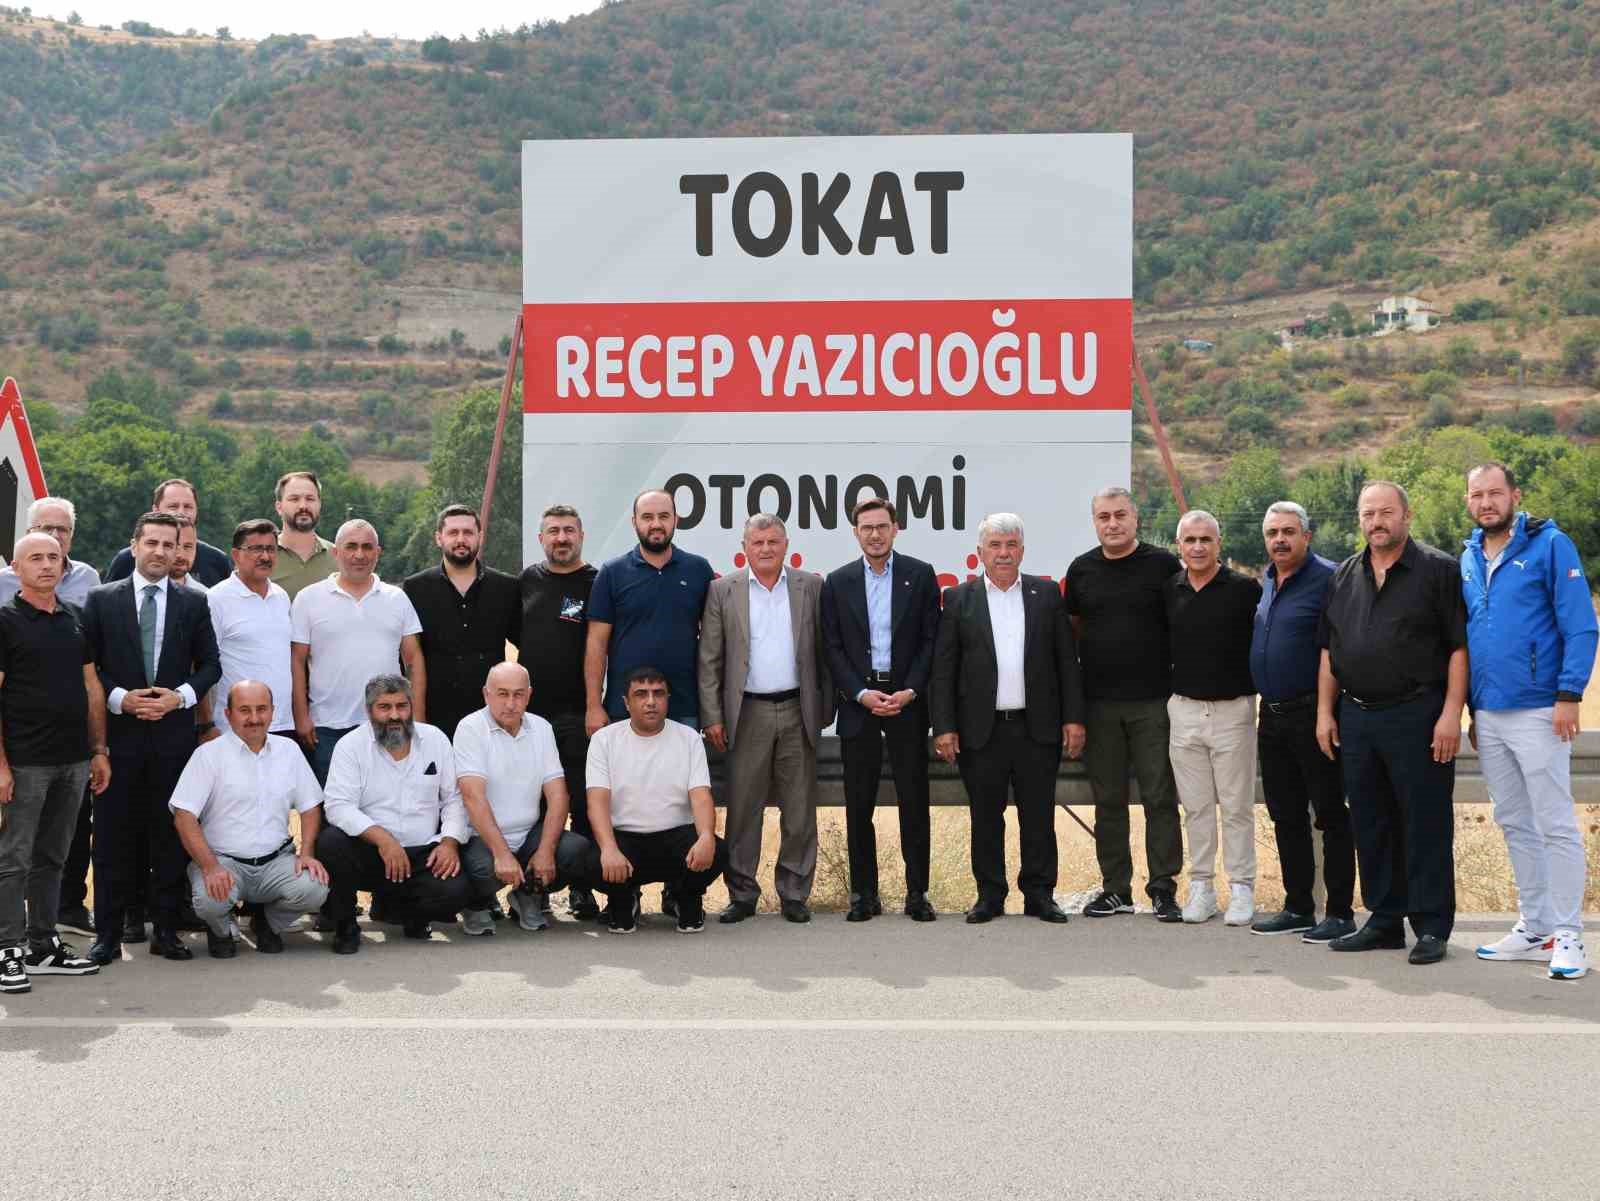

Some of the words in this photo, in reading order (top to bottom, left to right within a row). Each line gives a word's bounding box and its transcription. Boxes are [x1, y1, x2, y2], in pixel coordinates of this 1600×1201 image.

[679, 170, 965, 258] TOKAT
[555, 334, 735, 400] RECEP
[748, 308, 1099, 397] YAZICIOĞLU
